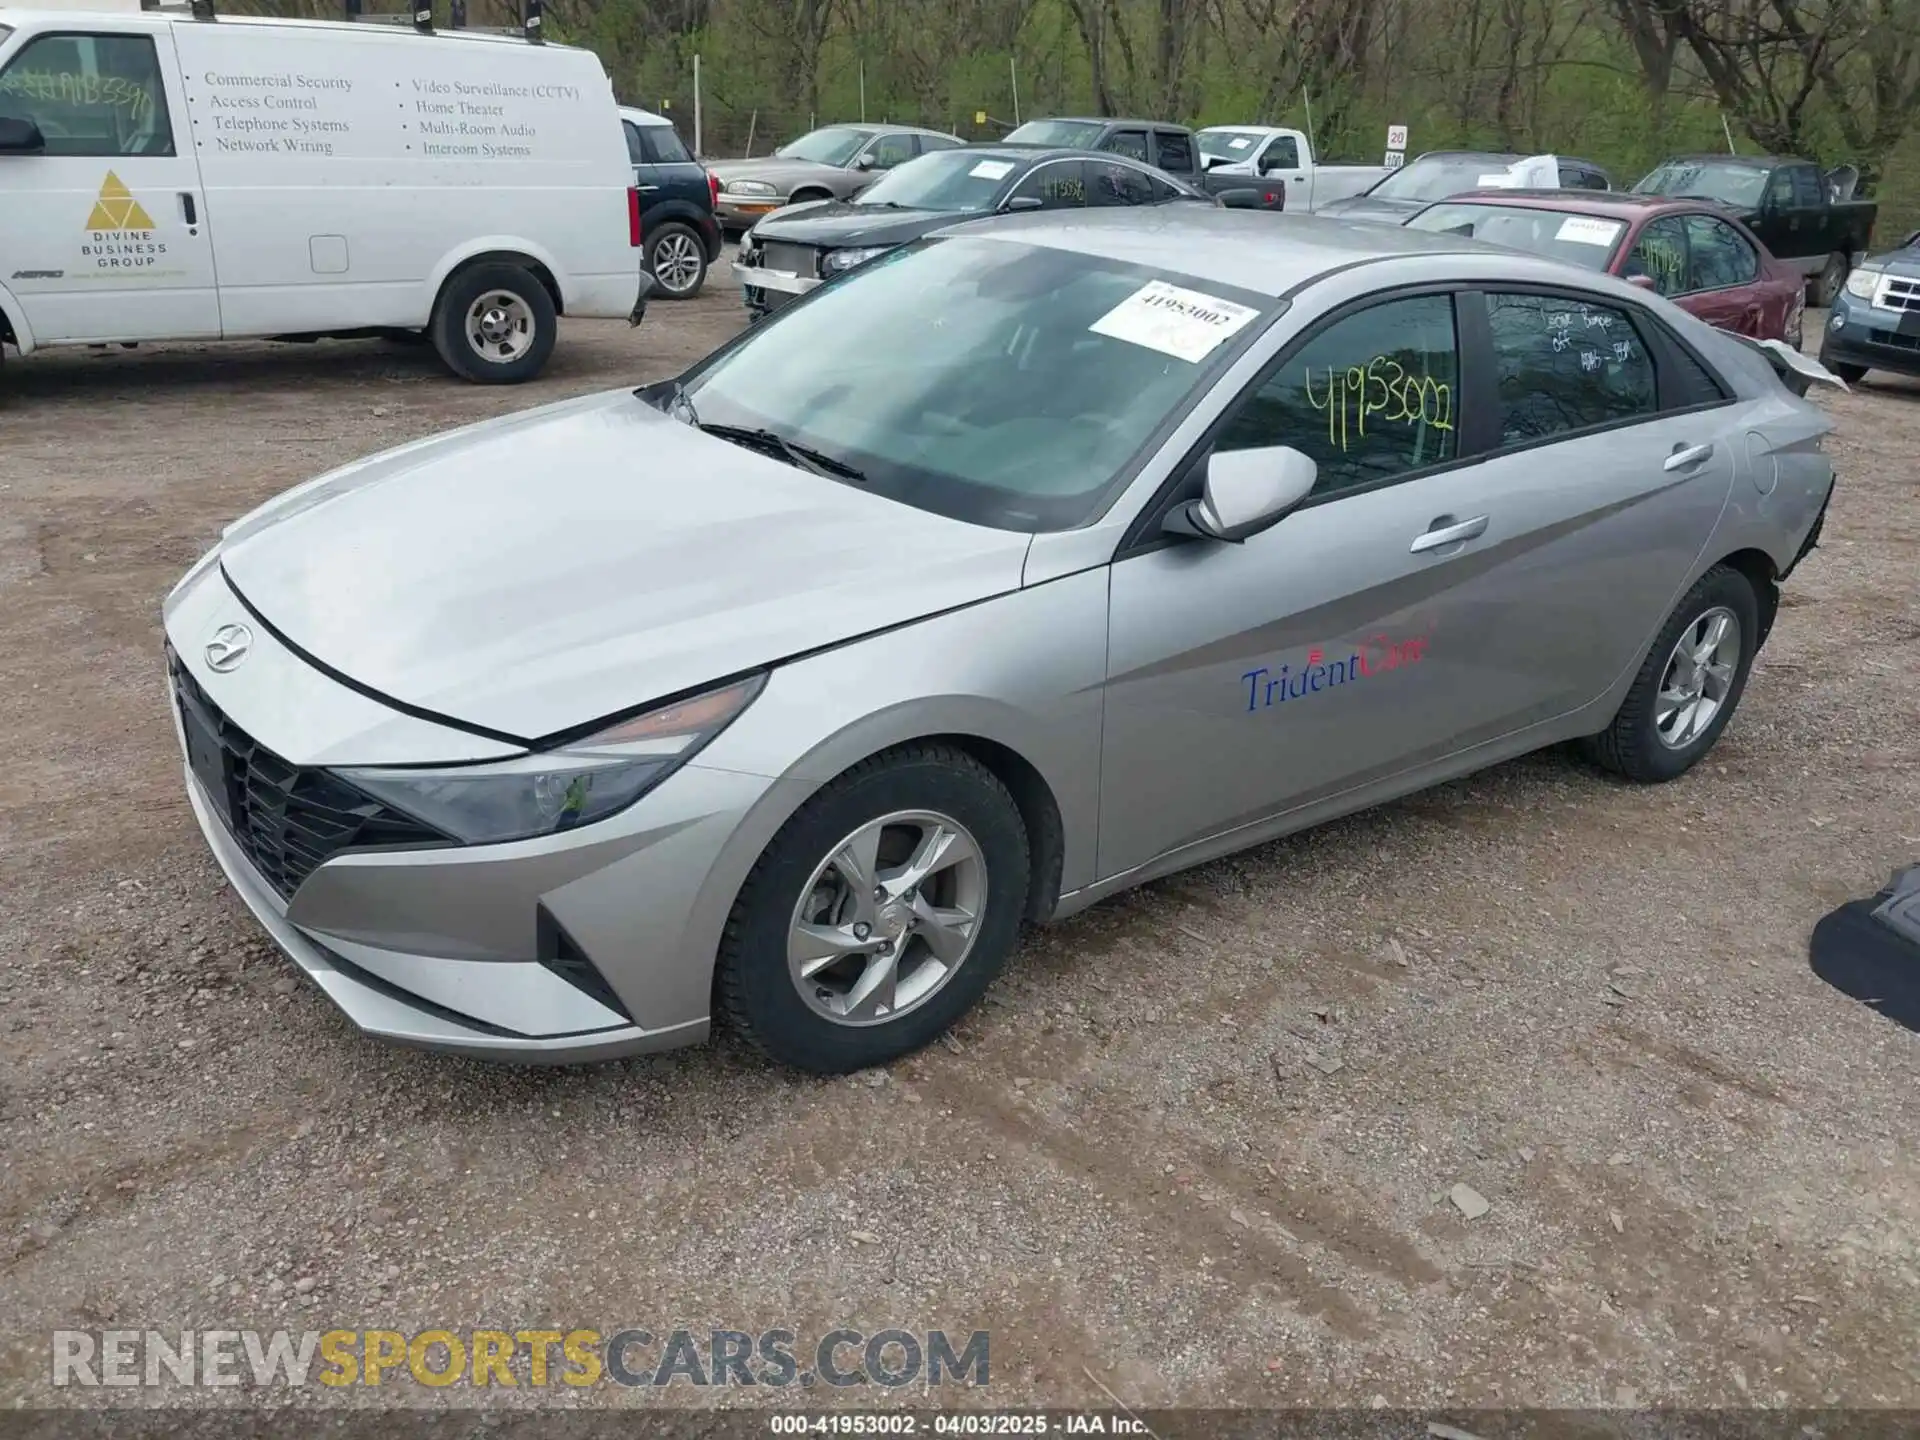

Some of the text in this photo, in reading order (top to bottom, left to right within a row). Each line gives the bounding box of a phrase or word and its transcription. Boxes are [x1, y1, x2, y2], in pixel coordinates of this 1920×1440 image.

[204, 71, 352, 92] Commercial Security
[411, 79, 580, 100] Video Surveillance (CCTV)
[210, 95, 317, 109] Access Control
[415, 100, 504, 116] Home Theater
[214, 115, 350, 134] Telephone Systems
[419, 121, 536, 137] Multi-Room Audio
[1391, 131, 1405, 144] 20
[215, 137, 333, 156] Network Wiring
[423, 141, 531, 158] Intercom Systems
[93, 231, 153, 242] DIVINE
[81, 244, 168, 256] BUSINESS
[97, 257, 156, 268] GROUP
[1142, 294, 1231, 326] 41953002
